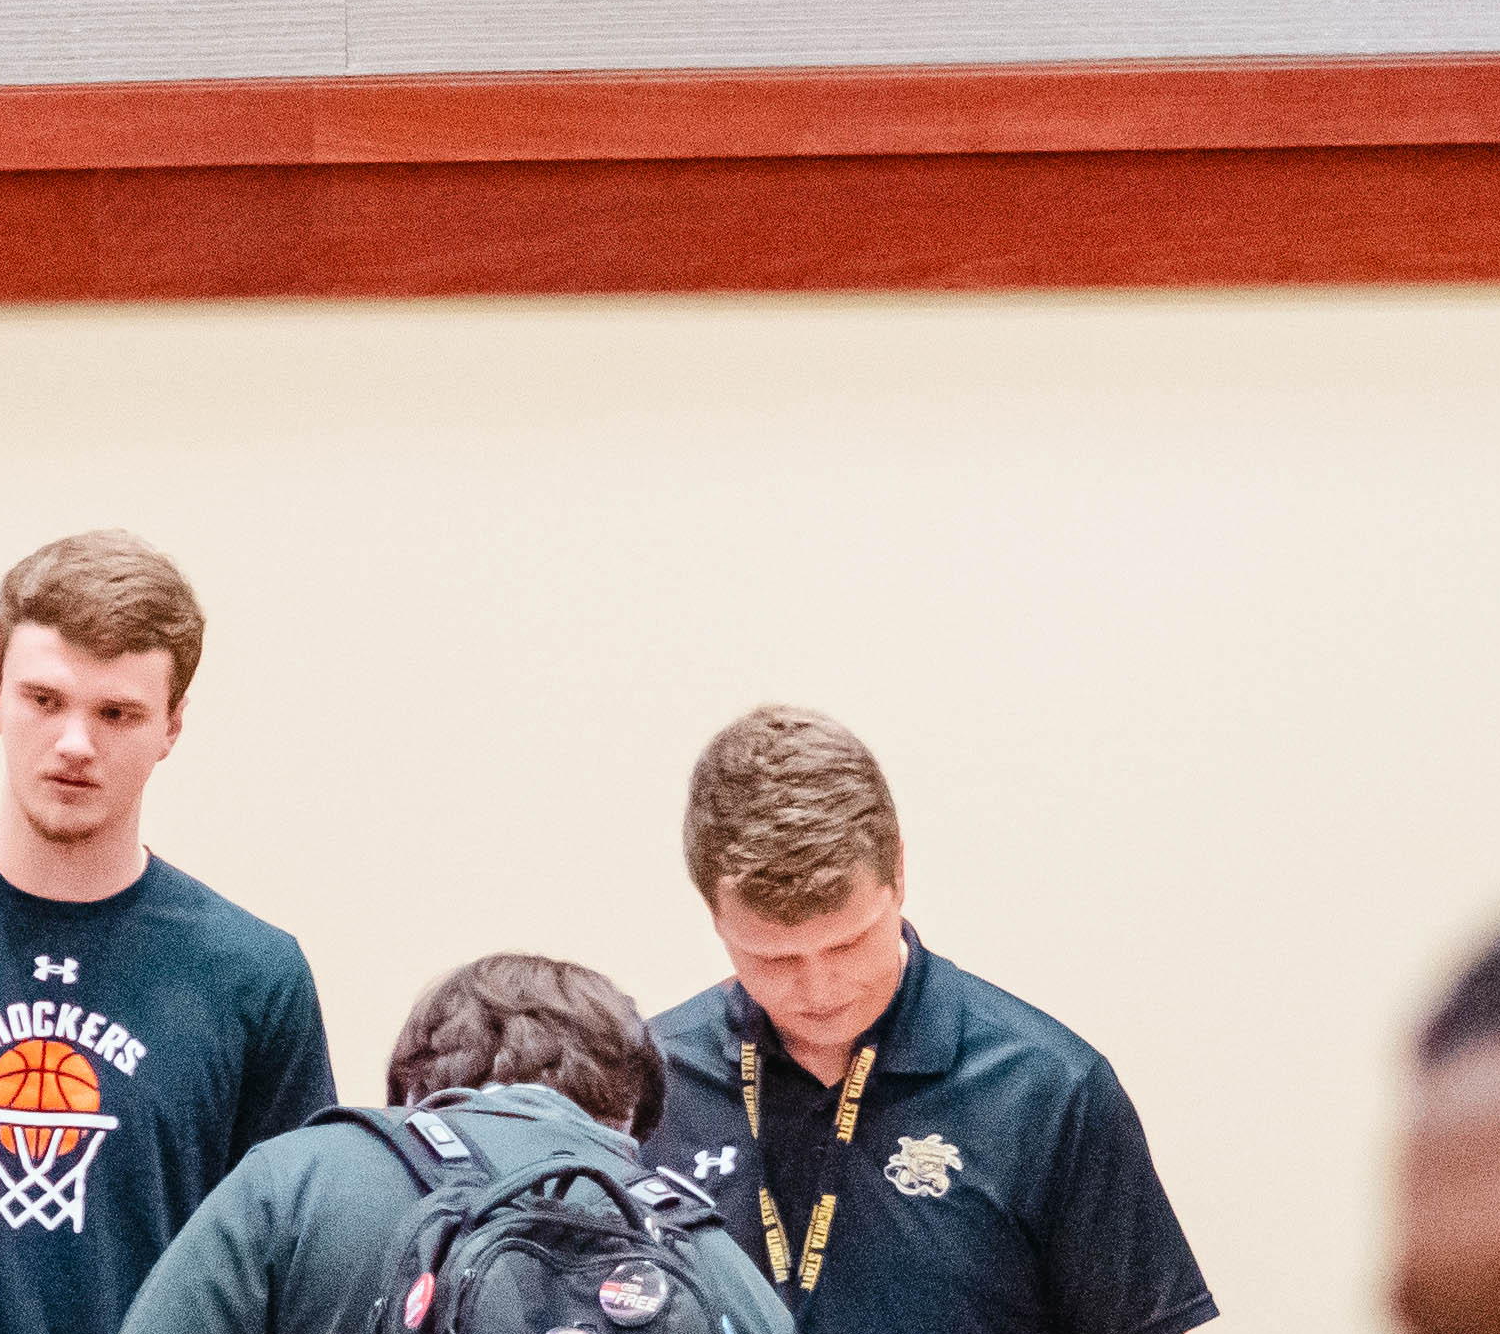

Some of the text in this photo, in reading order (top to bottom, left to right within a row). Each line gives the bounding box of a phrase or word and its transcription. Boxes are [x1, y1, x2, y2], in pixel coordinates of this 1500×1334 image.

[836, 1101, 859, 1143] STATE
[766, 1228, 788, 1283] WICHITA
[800, 1195, 836, 1291] WICHITA STATE
[614, 1293, 661, 1312] FREE
